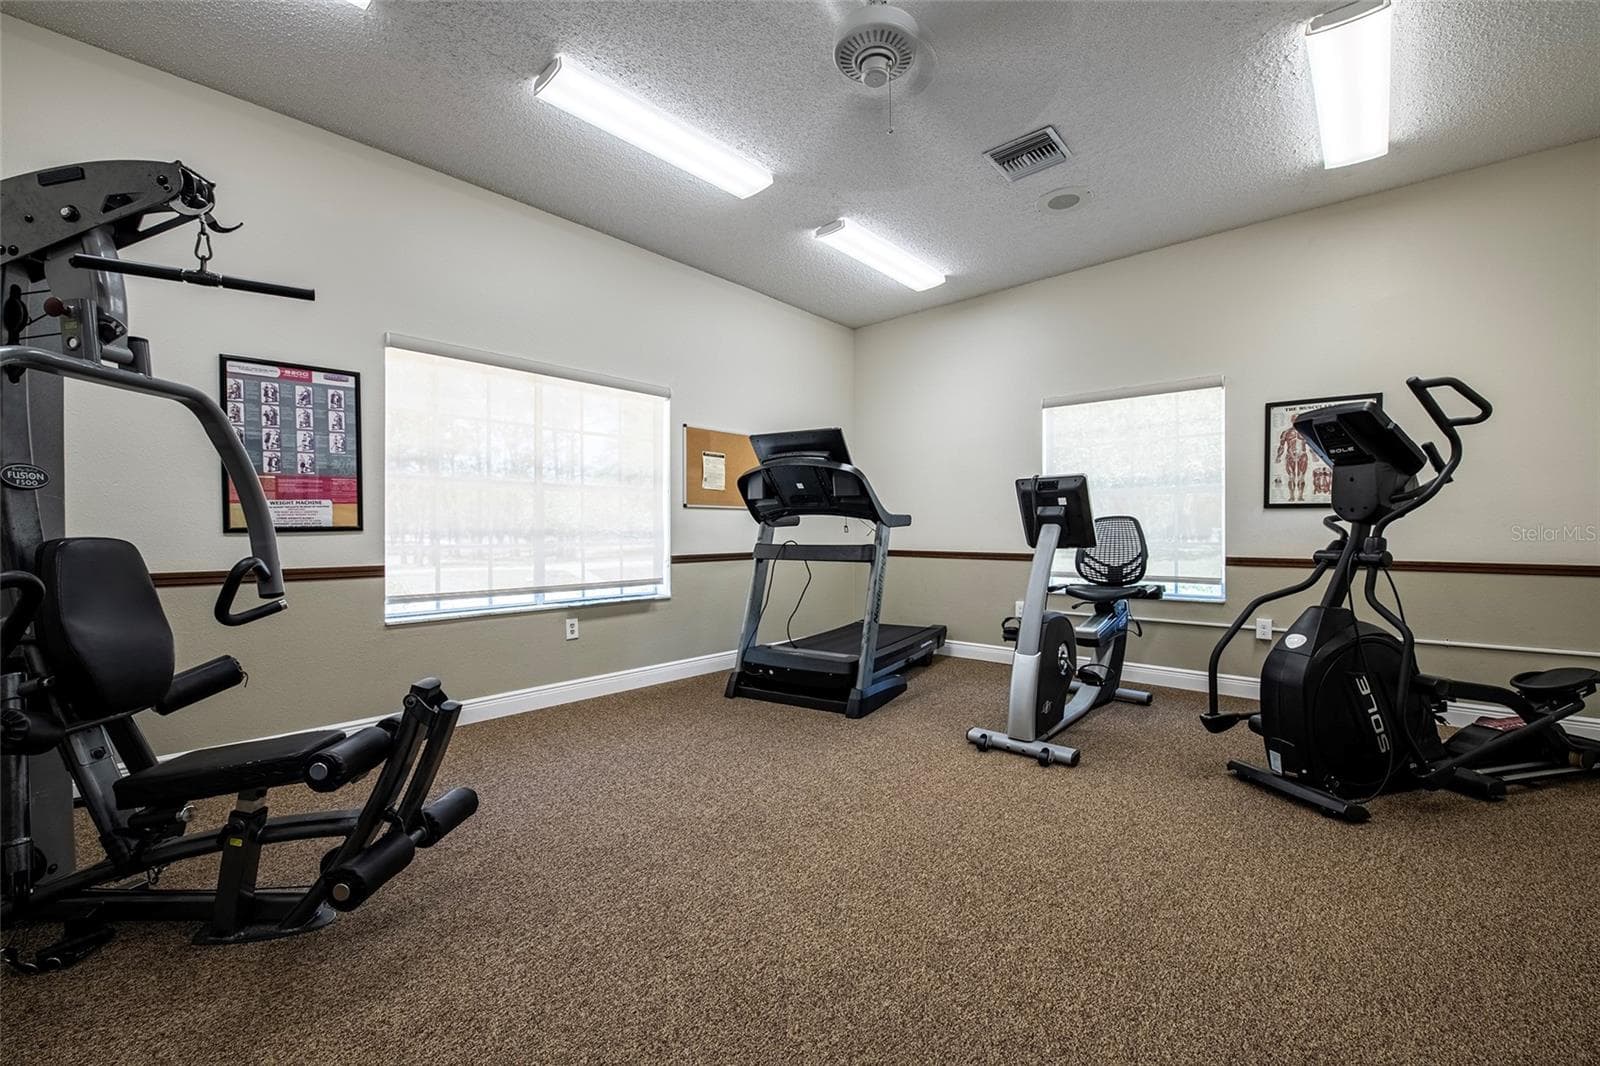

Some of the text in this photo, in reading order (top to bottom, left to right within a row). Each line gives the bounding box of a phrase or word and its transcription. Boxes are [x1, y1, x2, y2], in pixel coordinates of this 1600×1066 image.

[1329, 446, 1354, 454] SOLE
[7, 471, 44, 480] FUSION
[1355, 675, 1391, 753] SOLE
